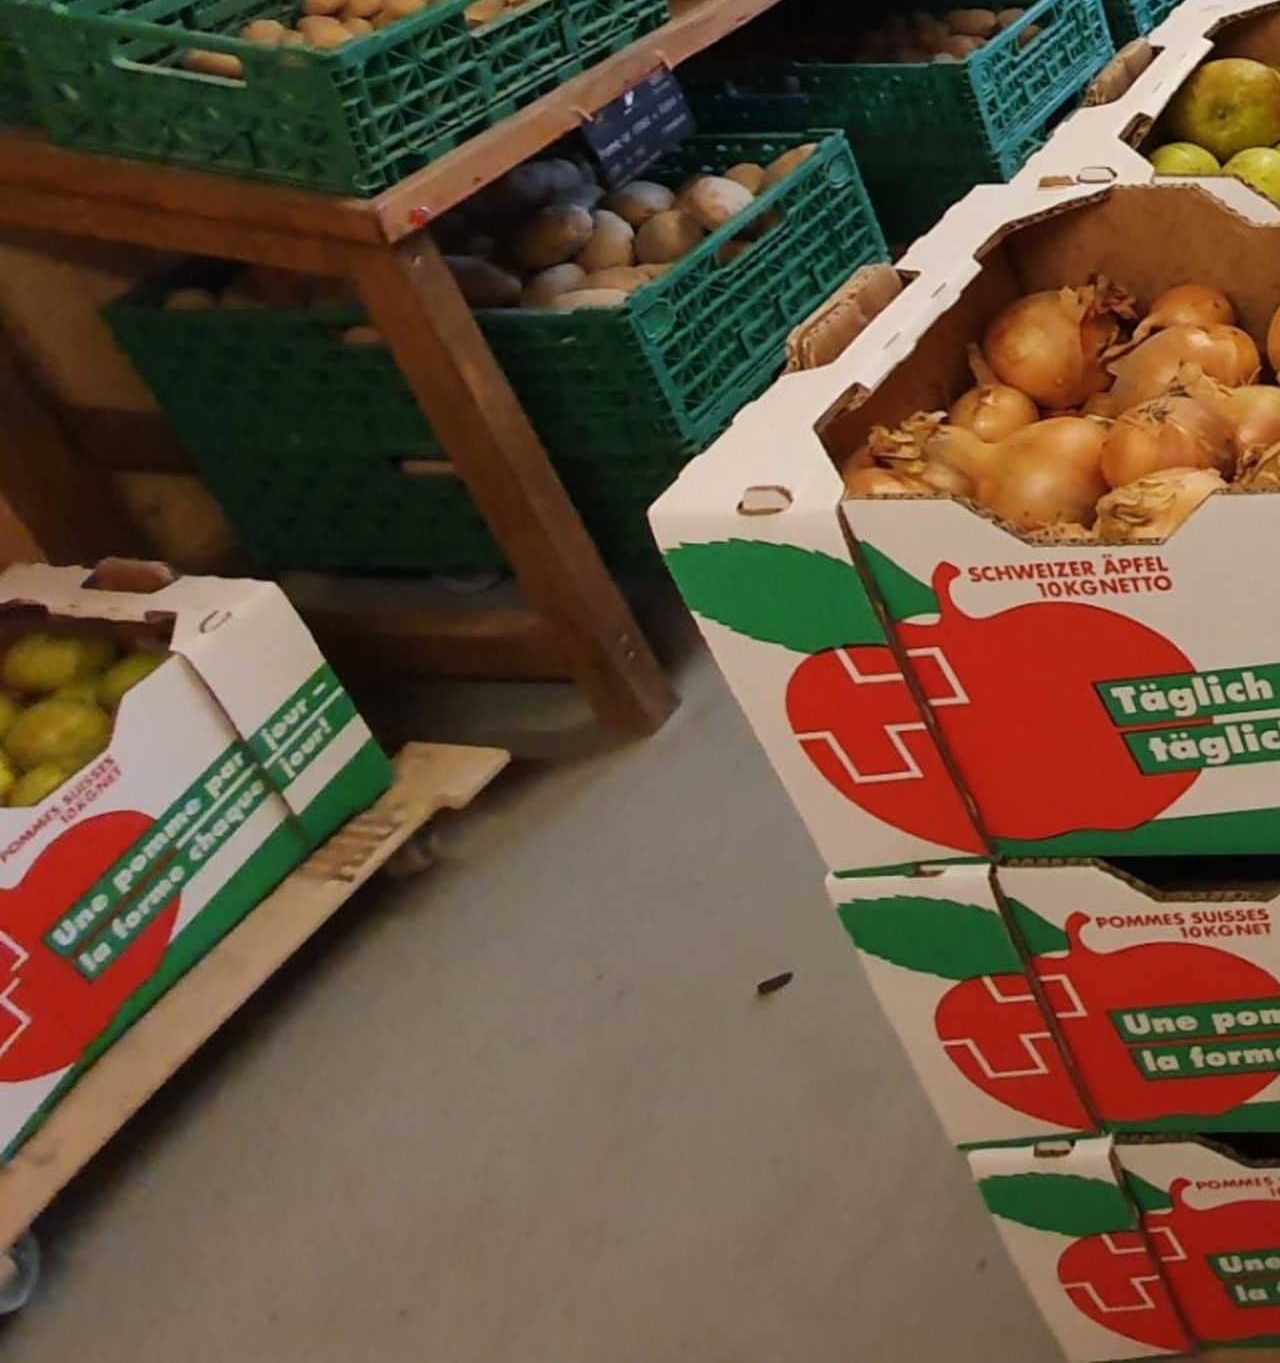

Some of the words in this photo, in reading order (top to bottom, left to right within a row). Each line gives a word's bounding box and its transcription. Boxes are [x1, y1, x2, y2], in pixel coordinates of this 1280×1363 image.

[968, 561, 1096, 583] SCHWEIZER
[1102, 554, 1168, 575] ÄPFEL
[1110, 671, 1273, 717] Täglich
[0, 807, 61, 863] POMMES
[62, 755, 115, 804] SUISSES
[53, 894, 109, 945] Une
[112, 798, 202, 894] pomme
[204, 751, 243, 799] par
[261, 698, 309, 748] jour
[80, 942, 112, 971] la
[112, 865, 185, 938] forme
[189, 780, 264, 860] chaque
[281, 720, 332, 779] jour!
[1095, 913, 1185, 930] POMMES
[1190, 908, 1269, 924] SUISSES
[1122, 1013, 1197, 1035] Une
[1143, 1050, 1179, 1072] la
[1196, 1176, 1273, 1192] POMMES
[1235, 1284, 1267, 1303] la
